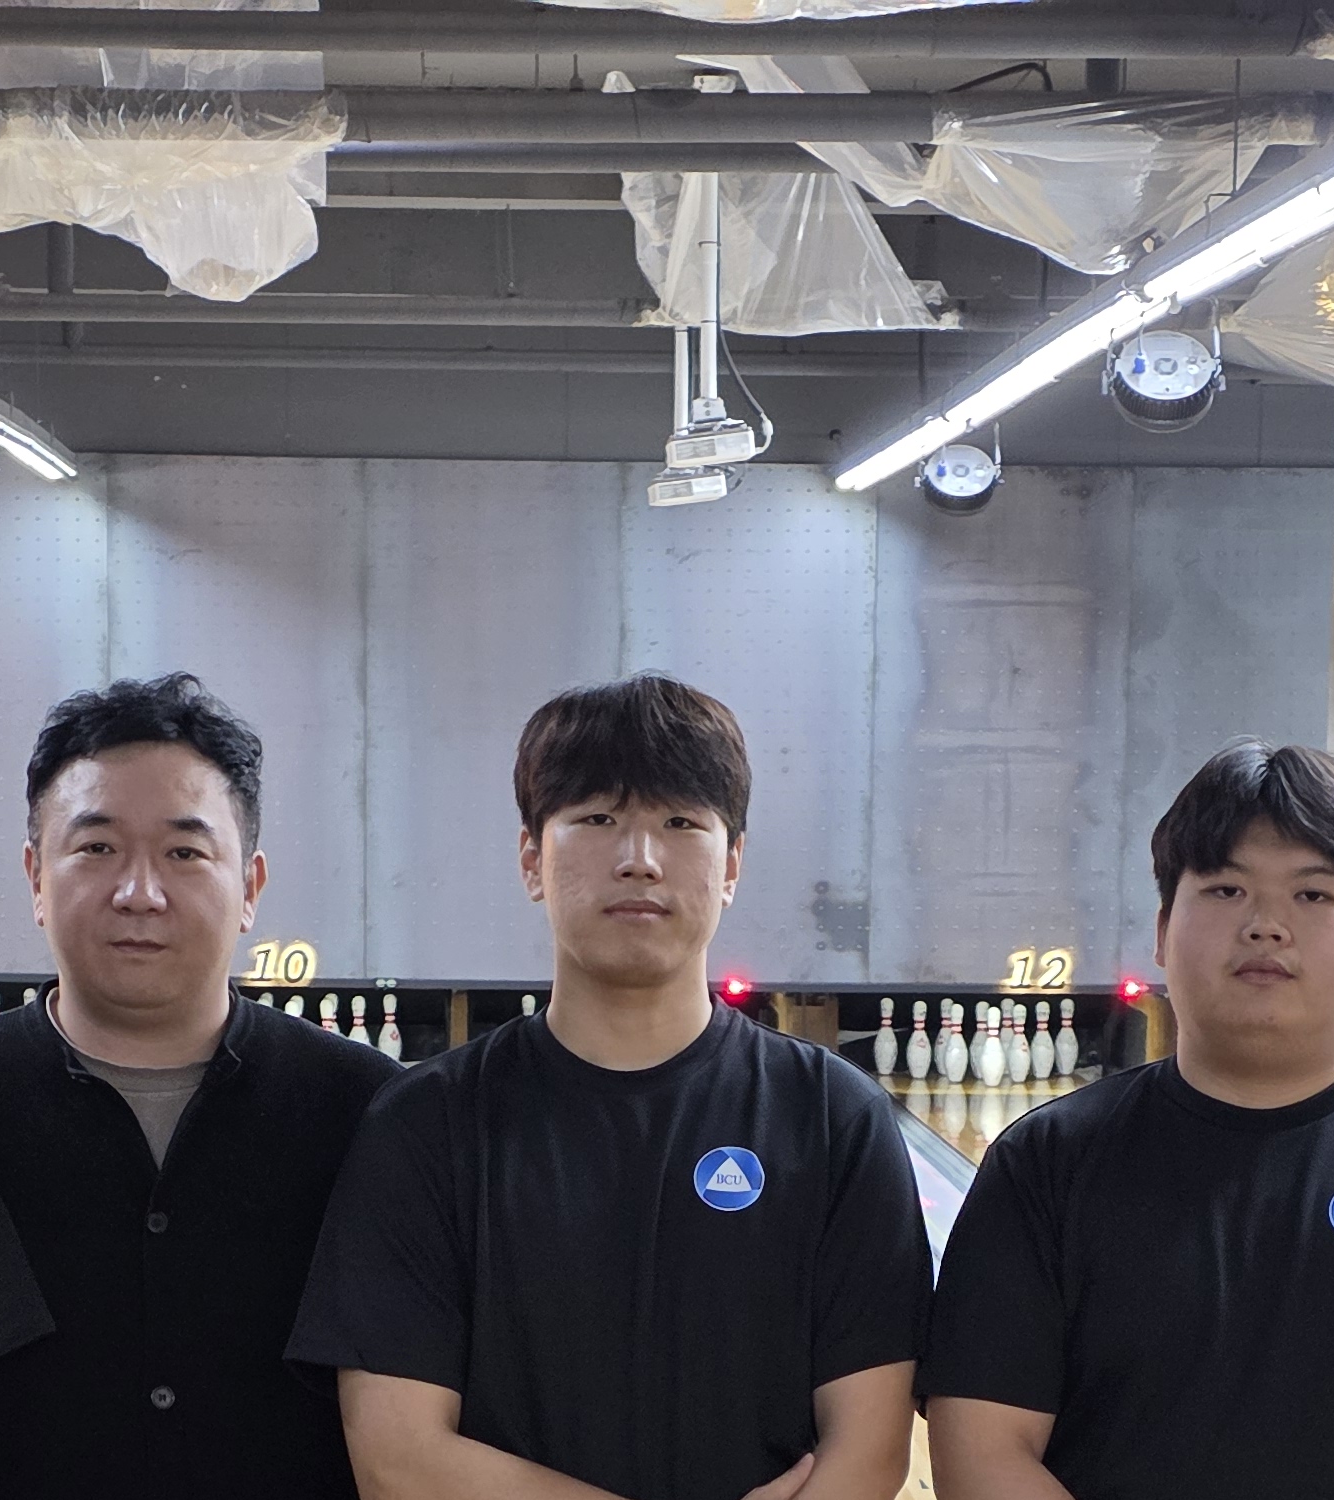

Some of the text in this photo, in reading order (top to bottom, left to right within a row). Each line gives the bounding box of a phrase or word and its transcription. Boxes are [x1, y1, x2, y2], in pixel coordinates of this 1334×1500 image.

[246, 946, 313, 985] 10
[1005, 953, 1069, 991] 12
[716, 1173, 743, 1186] BCU
